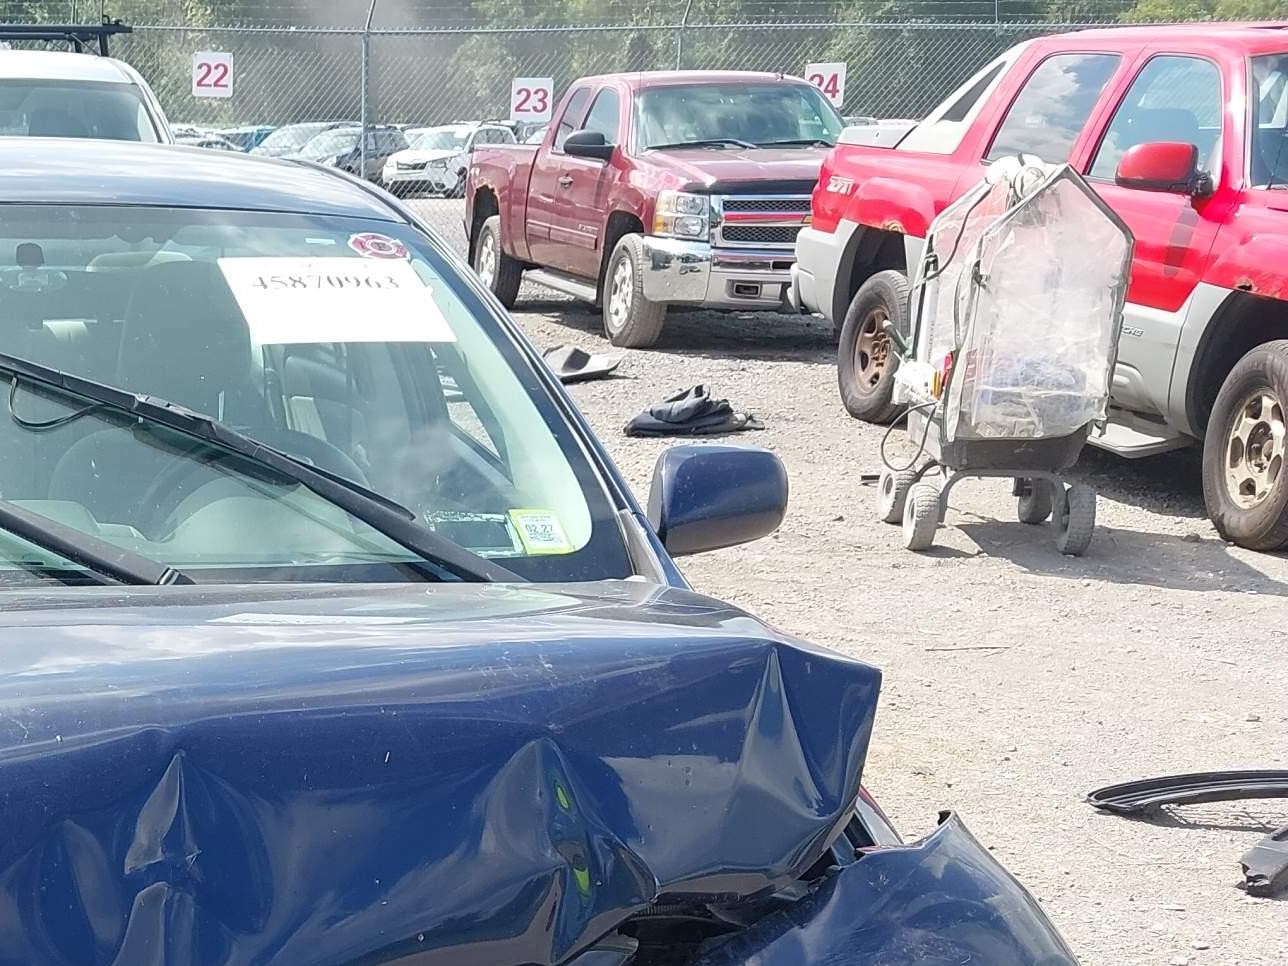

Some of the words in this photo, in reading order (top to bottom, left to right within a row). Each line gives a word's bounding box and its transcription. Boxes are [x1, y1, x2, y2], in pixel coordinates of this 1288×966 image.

[196, 62, 229, 88] 22
[514, 87, 548, 113] 23
[252, 274, 400, 290] 45870963
